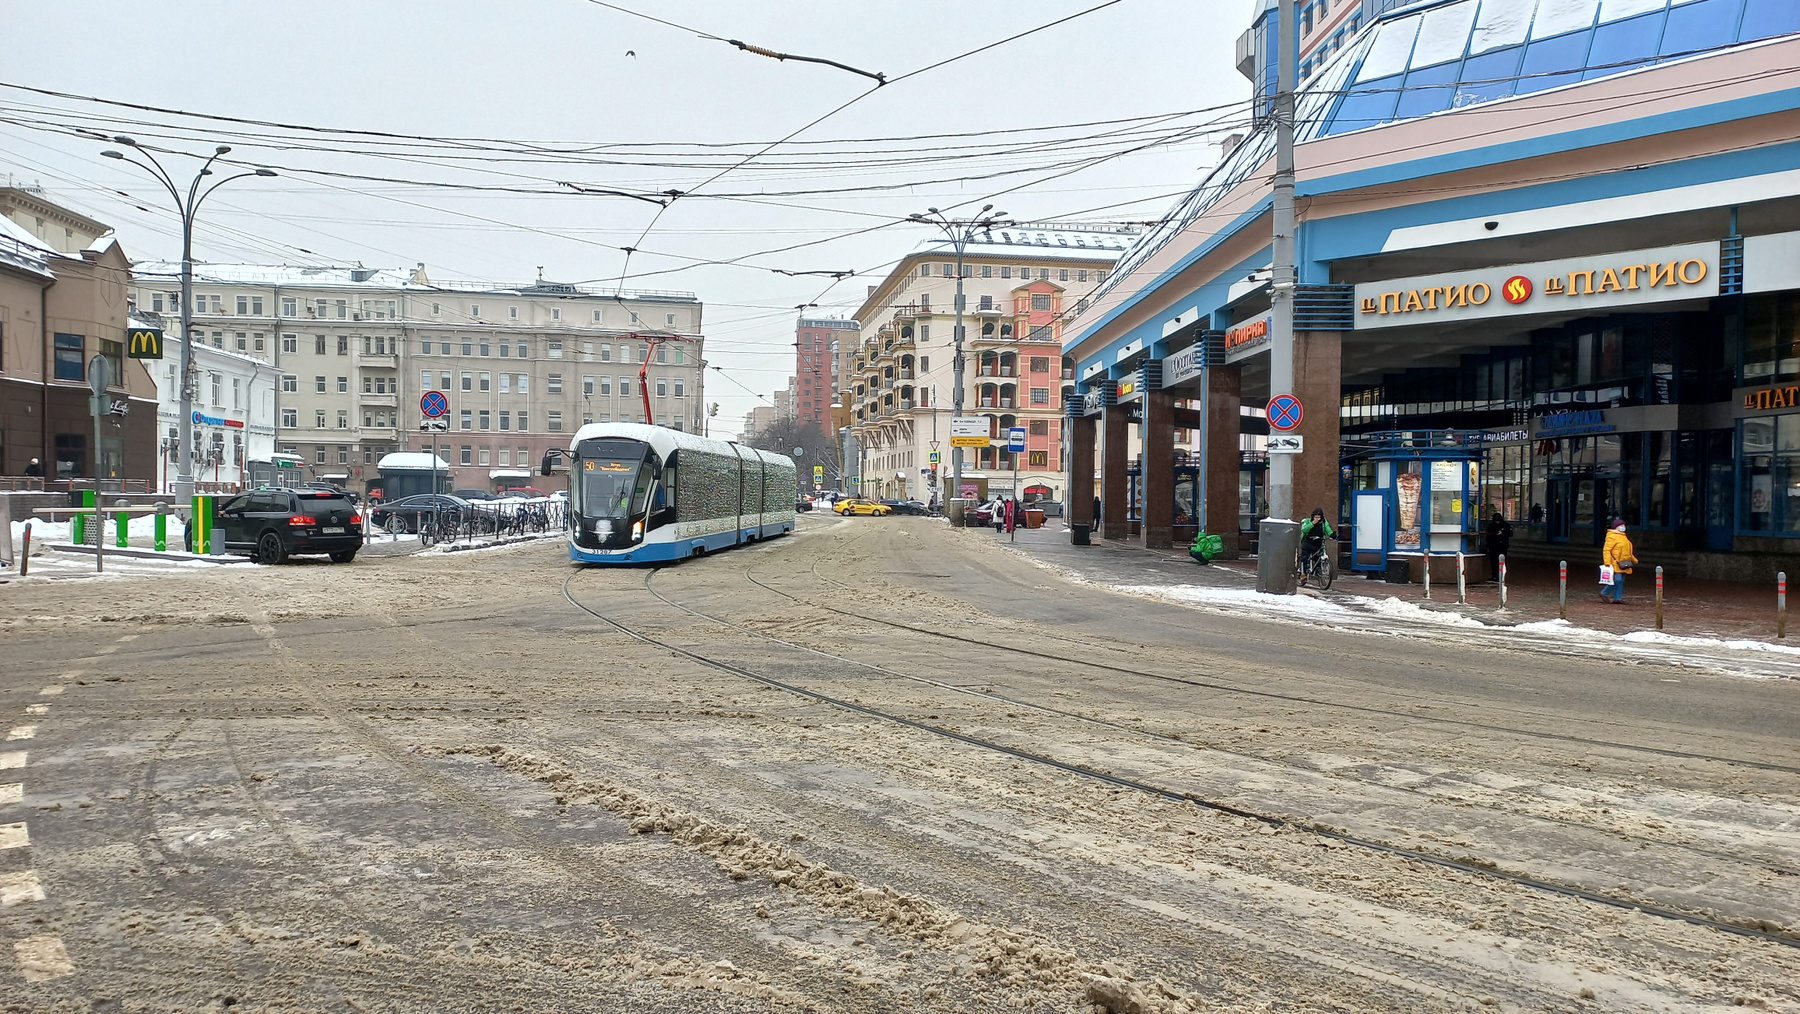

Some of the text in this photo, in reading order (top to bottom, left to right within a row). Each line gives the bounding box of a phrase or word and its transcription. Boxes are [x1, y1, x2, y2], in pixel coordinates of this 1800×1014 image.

[1566, 258, 1708, 297] ПАТИО
[1378, 281, 1492, 315] ПАТИО
[1483, 429, 1529, 442] АВИАБИЛЕТЫ
[585, 461, 596, 471] 50
